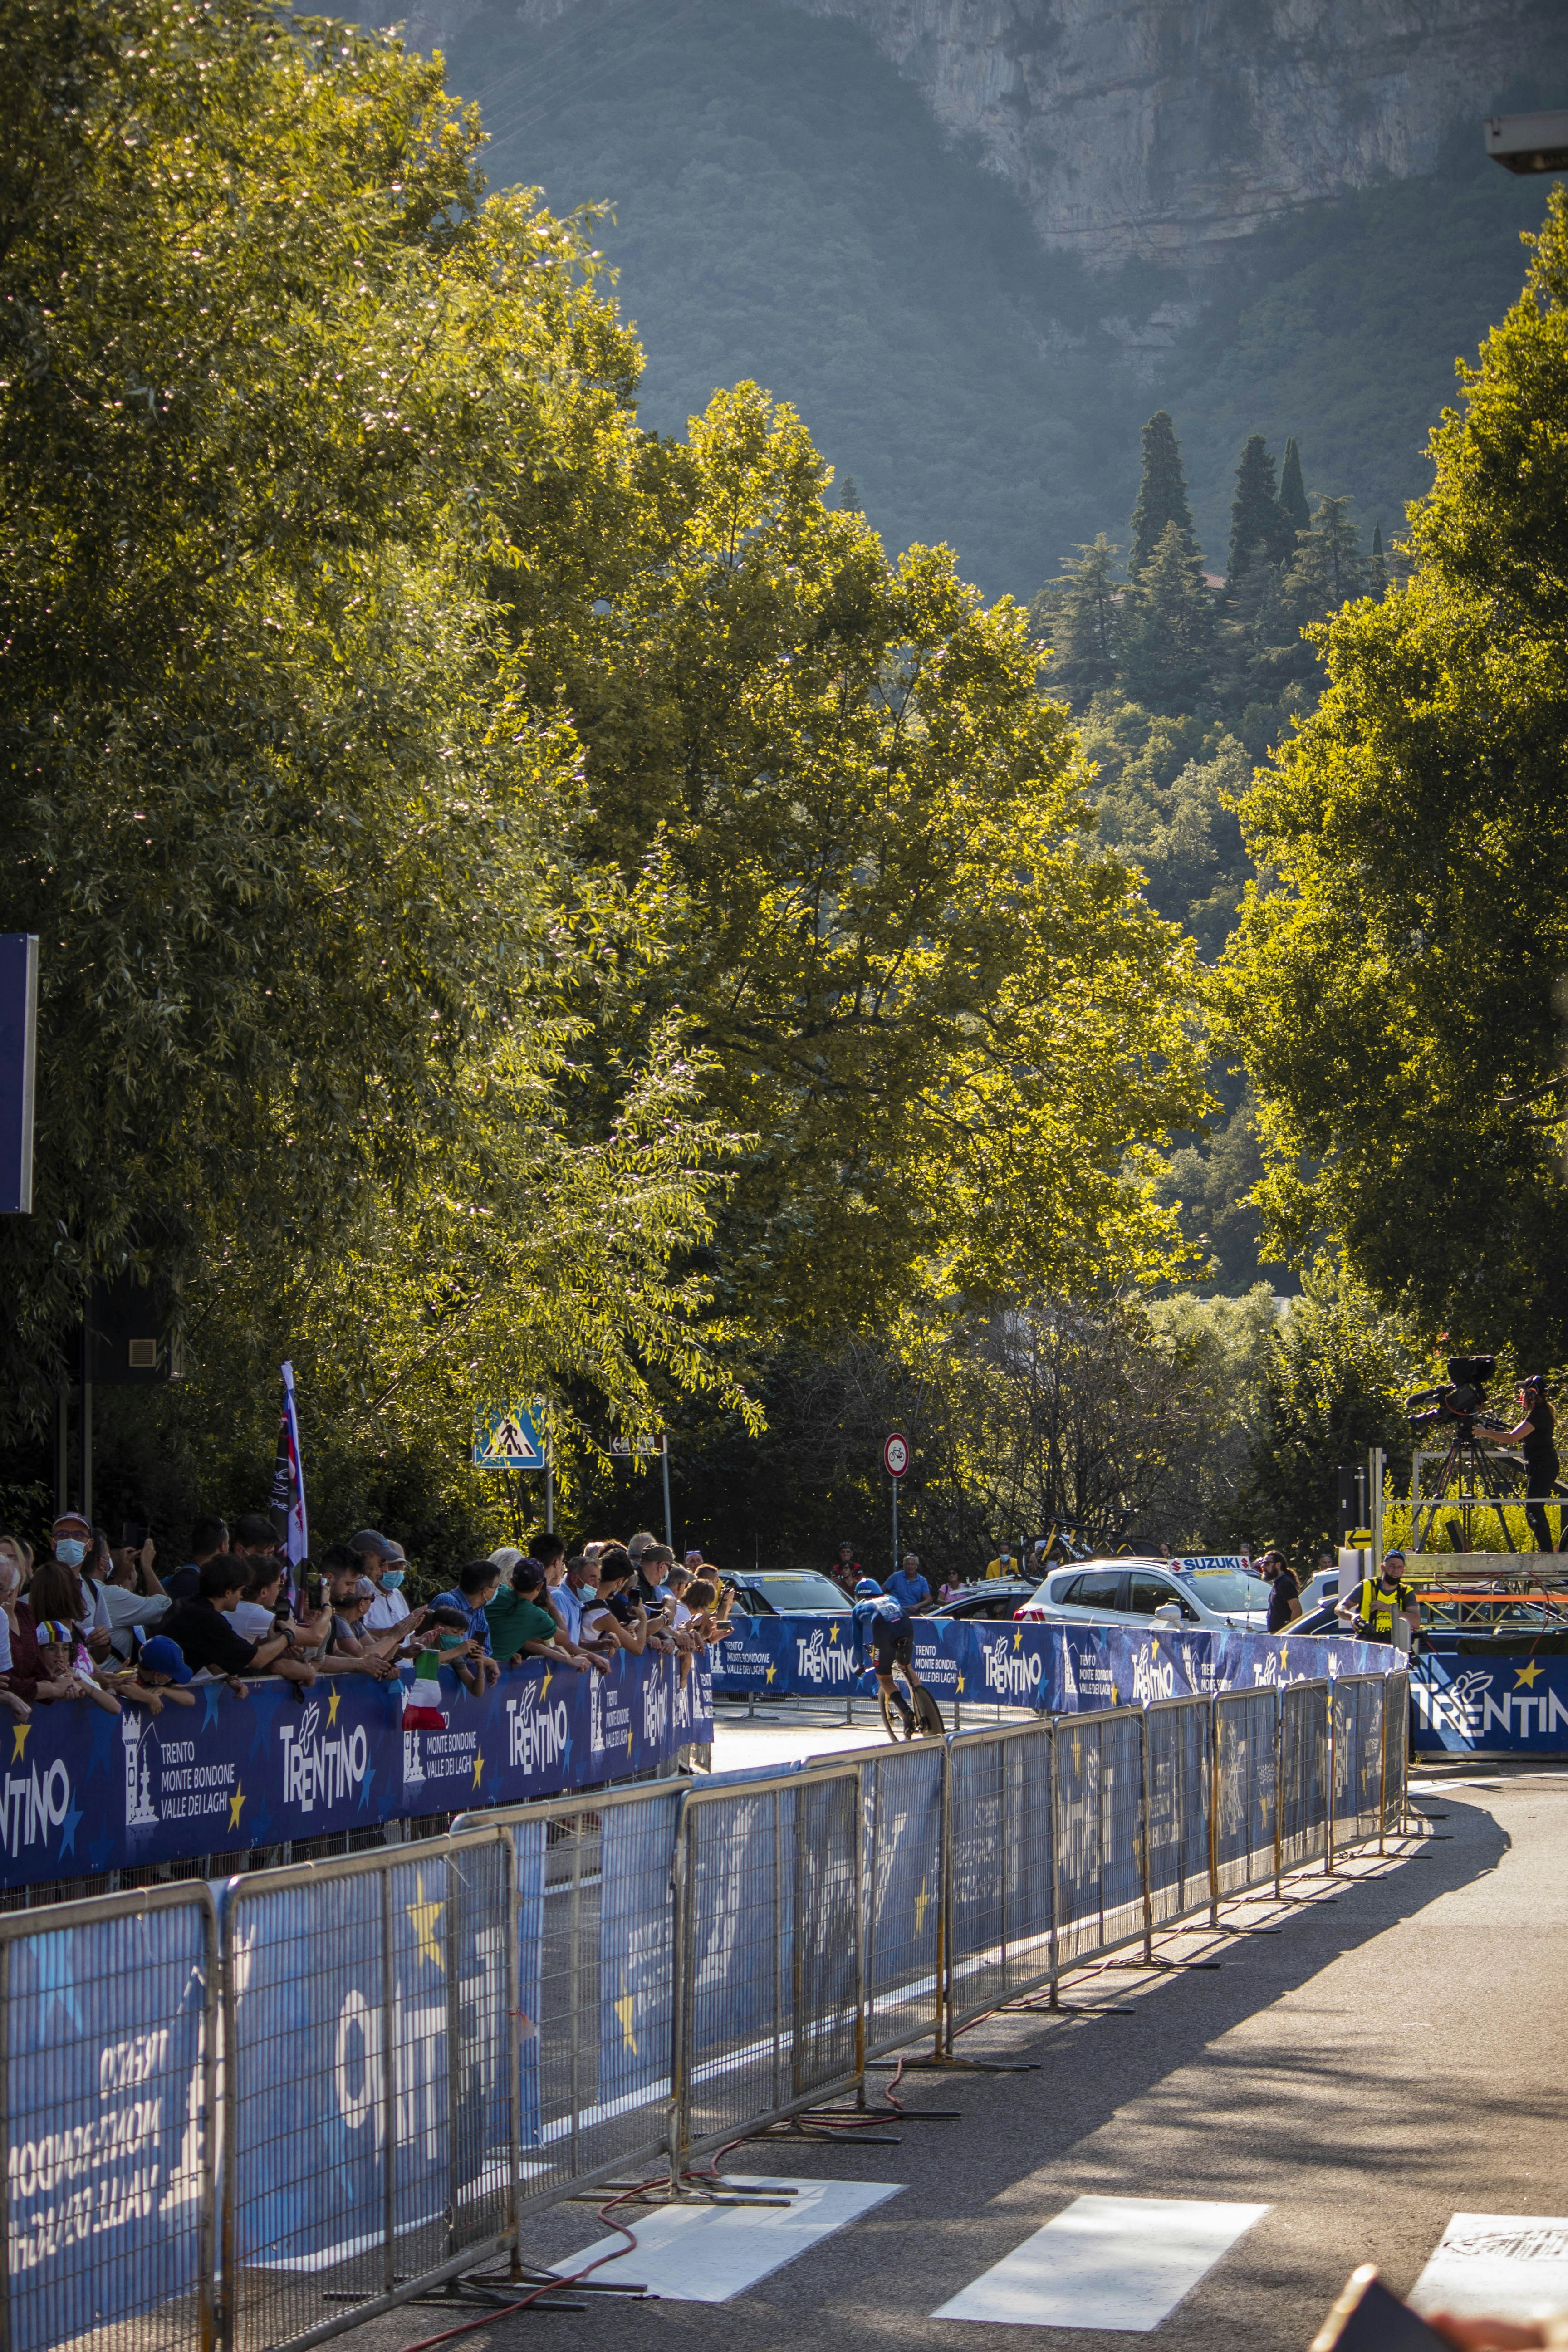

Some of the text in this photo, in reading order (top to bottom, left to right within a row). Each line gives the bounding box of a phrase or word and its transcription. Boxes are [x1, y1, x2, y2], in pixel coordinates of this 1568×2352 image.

[1183, 1557, 1240, 1571] SUZUKI
[724, 1641, 743, 1651] TRENTO
[915, 1645, 936, 1656] TRENTO
[727, 1652, 770, 1663] MONTE BONDONE
[915, 1658, 934, 1669] MONTE
[727, 1664, 742, 1674] VALLE
[751, 1666, 764, 1675] LAGHI
[983, 1646, 1042, 1695] TRENTINO
[1079, 1669, 1094, 1680] MONTE
[916, 1672, 956, 1683] VALLE DEI LAGHI
[1079, 1683, 1092, 1694] VALLE
[427, 1731, 476, 1755] MONTE BONDONE
[506, 1700, 567, 1775] TRENTINO
[161, 1741, 195, 1764] TRENTO
[279, 1724, 367, 1813] TRENTINO
[427, 1755, 472, 1779] VALLE DEI LAGHI
[161, 1763, 235, 1793] MONTE BONDONE
[161, 1791, 227, 1820] VALLE DEI LAGHI
